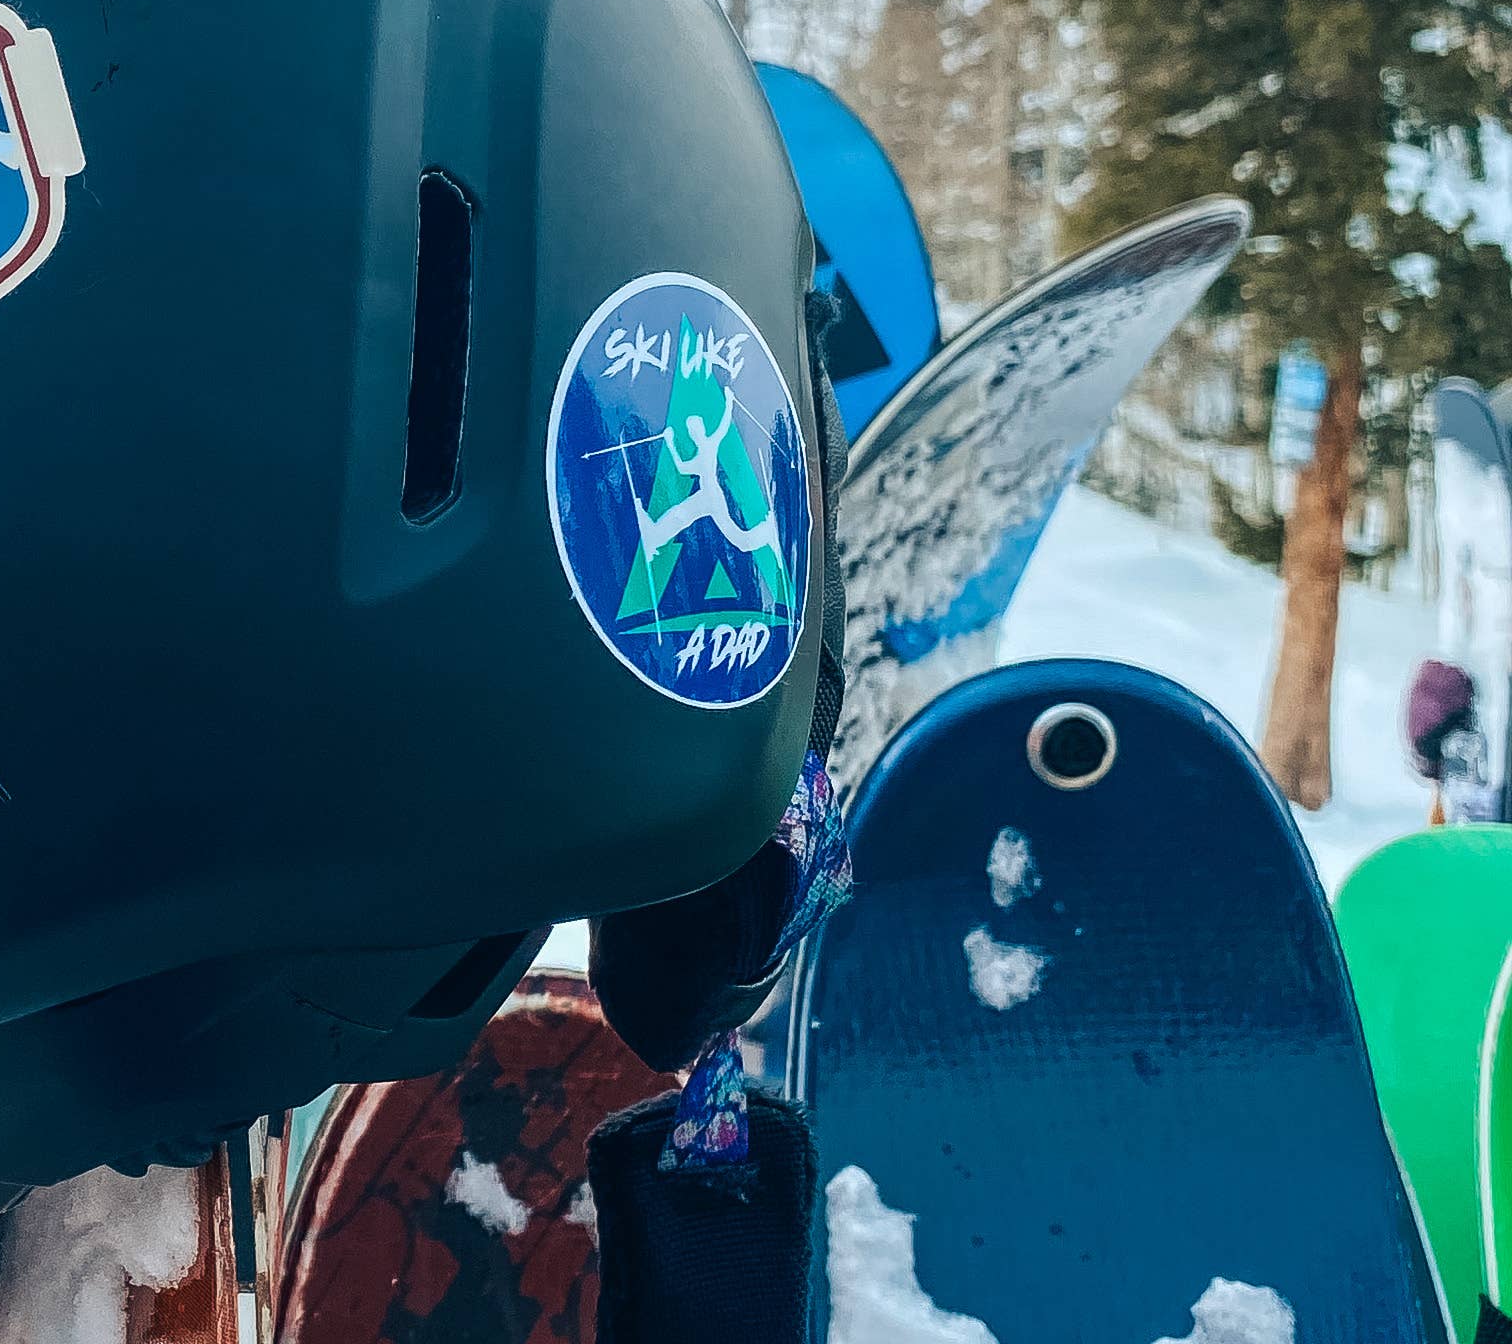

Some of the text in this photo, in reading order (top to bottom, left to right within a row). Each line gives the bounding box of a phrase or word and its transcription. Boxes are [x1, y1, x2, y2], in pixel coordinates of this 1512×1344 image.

[600, 321, 750, 383] SKI LIKE
[674, 619, 770, 678] A DAD
